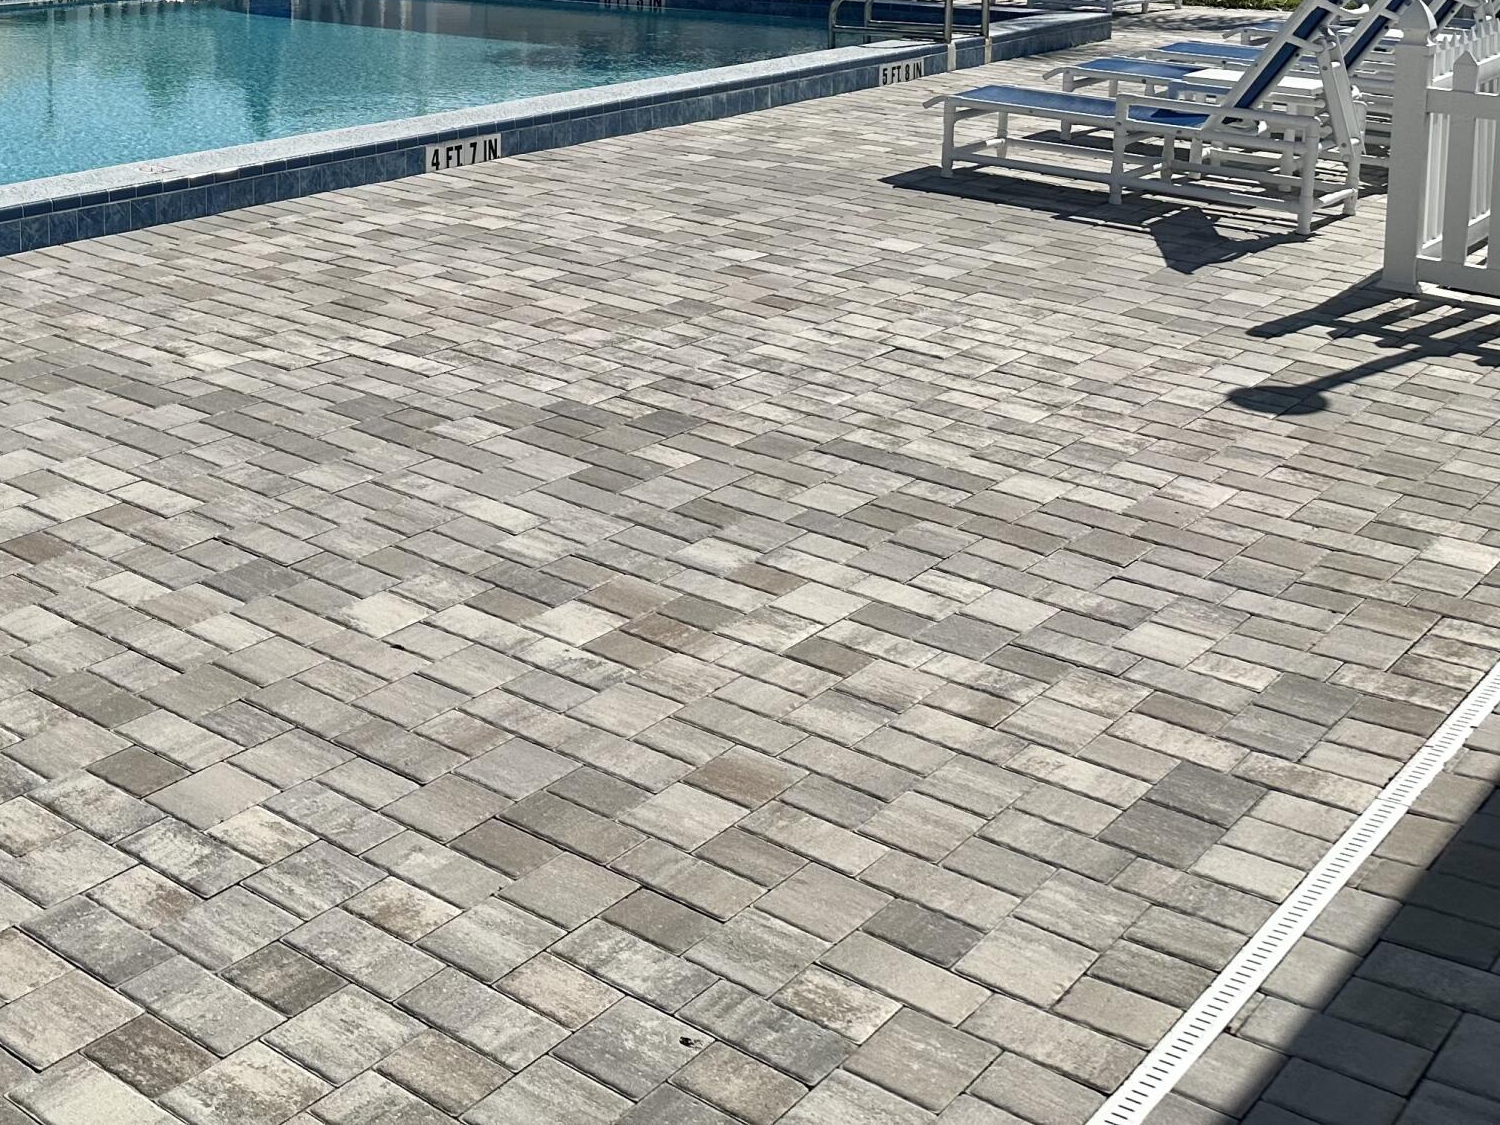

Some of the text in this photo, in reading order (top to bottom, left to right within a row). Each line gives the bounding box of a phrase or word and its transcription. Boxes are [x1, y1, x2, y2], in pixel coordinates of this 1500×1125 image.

[882, 68, 888, 85] 5
[905, 63, 910, 81] 8
[431, 148, 440, 171] 4
[446, 144, 463, 168] FT.
[469, 141, 478, 164] 7
